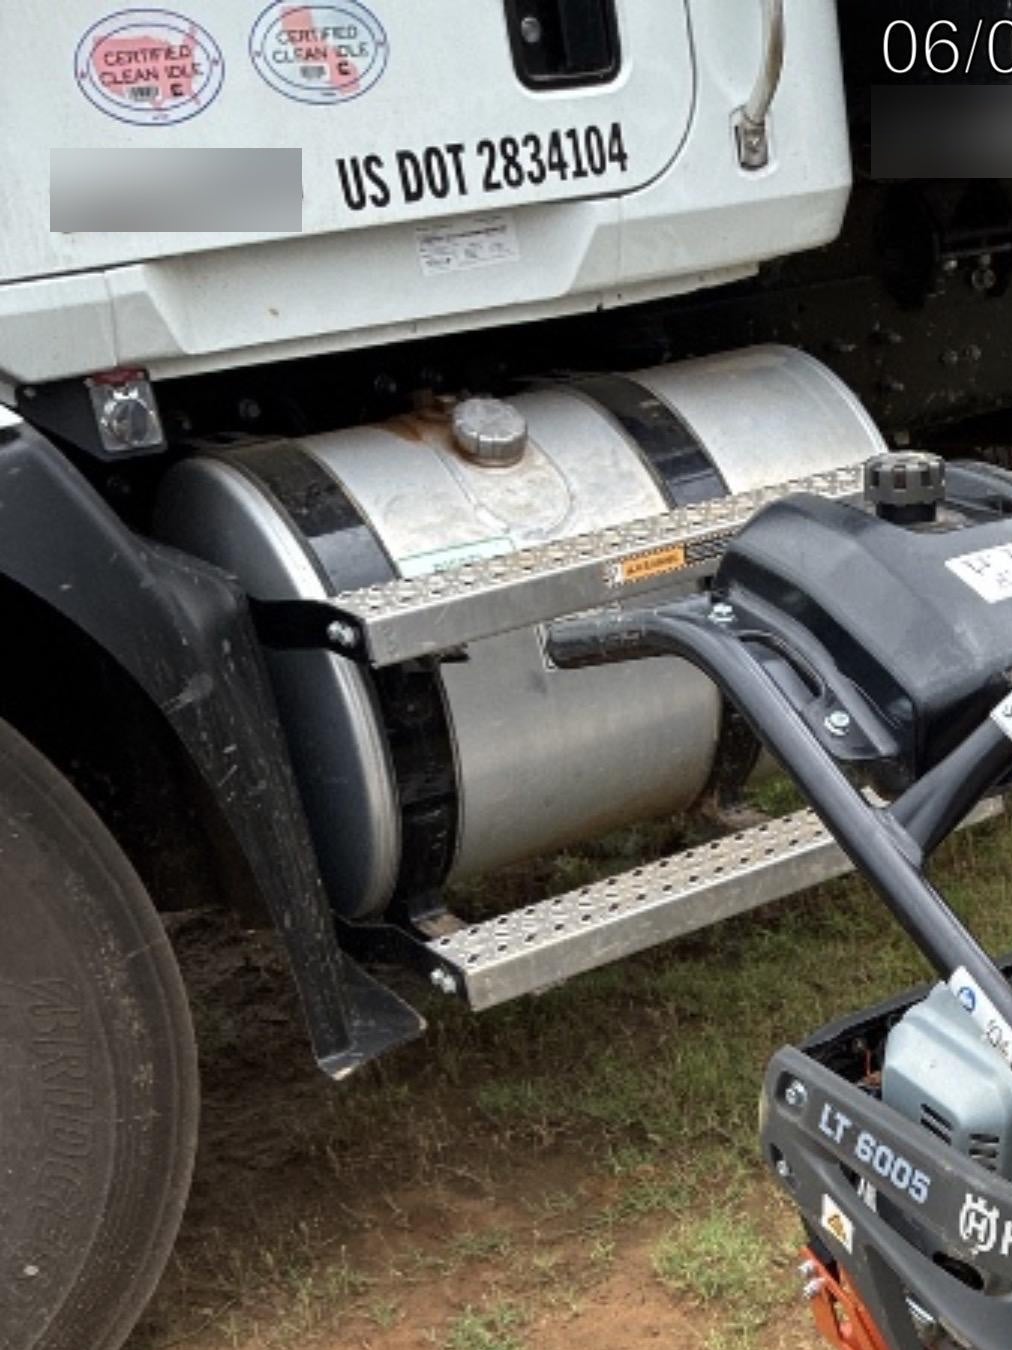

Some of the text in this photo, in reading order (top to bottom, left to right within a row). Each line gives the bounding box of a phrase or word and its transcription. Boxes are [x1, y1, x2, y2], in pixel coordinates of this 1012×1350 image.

[275, 23, 359, 45] CERTIFIED
[103, 44, 193, 67] CERTIFIED
[272, 42, 370, 64] CLEAN IDLE
[100, 62, 205, 87] CLEAN IDLE
[336, 121, 629, 211] US DOT 2834104
[816, 1102, 932, 1204] LT 6005
